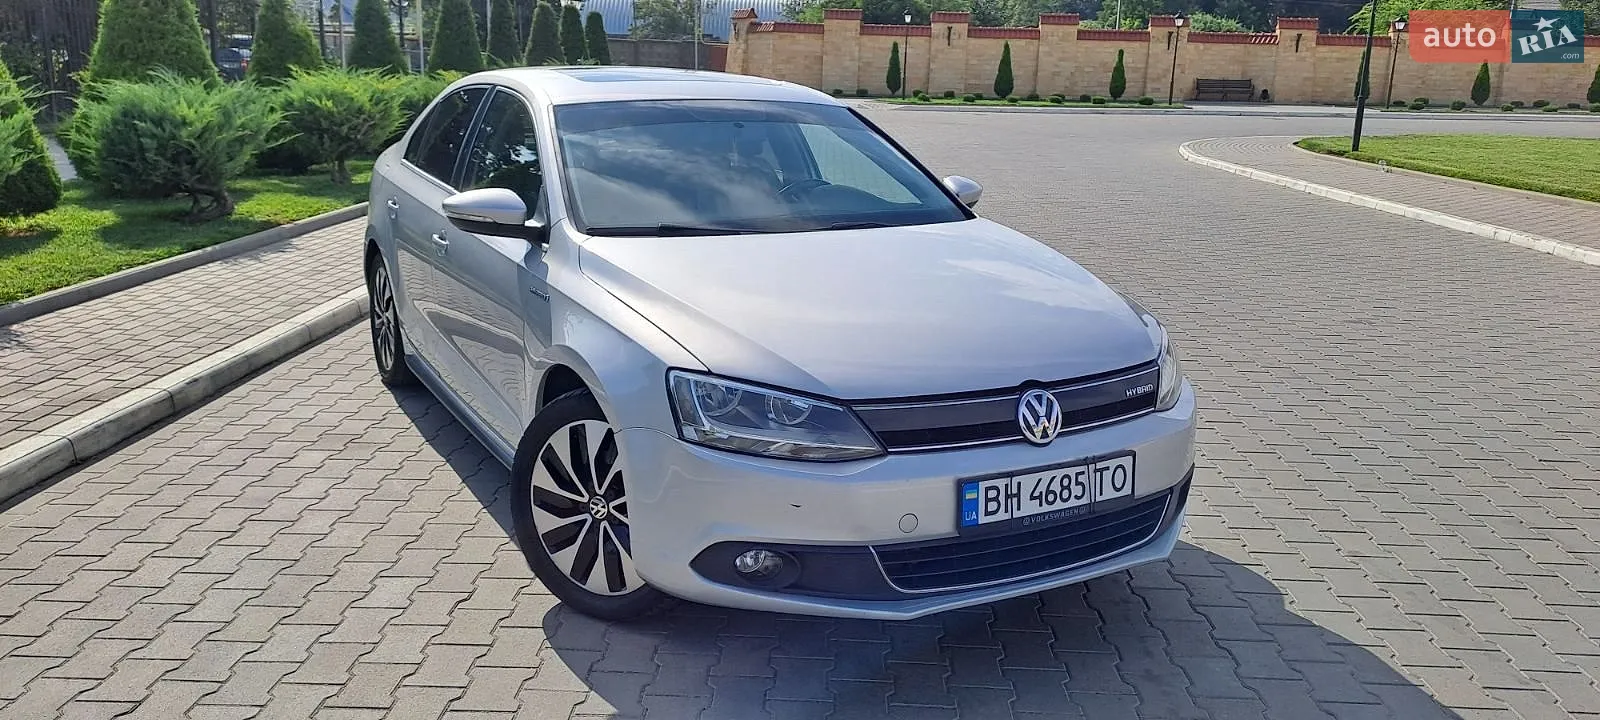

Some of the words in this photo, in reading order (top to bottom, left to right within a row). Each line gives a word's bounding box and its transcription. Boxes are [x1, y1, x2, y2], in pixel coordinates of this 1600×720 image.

[1126, 384, 1154, 397] HYBRID
[984, 481, 1021, 517] BH
[1029, 471, 1086, 508] 4685
[1094, 464, 1127, 497] TO
[965, 511, 977, 521] UA
[1030, 508, 1079, 523] VOLKSWAGEN
